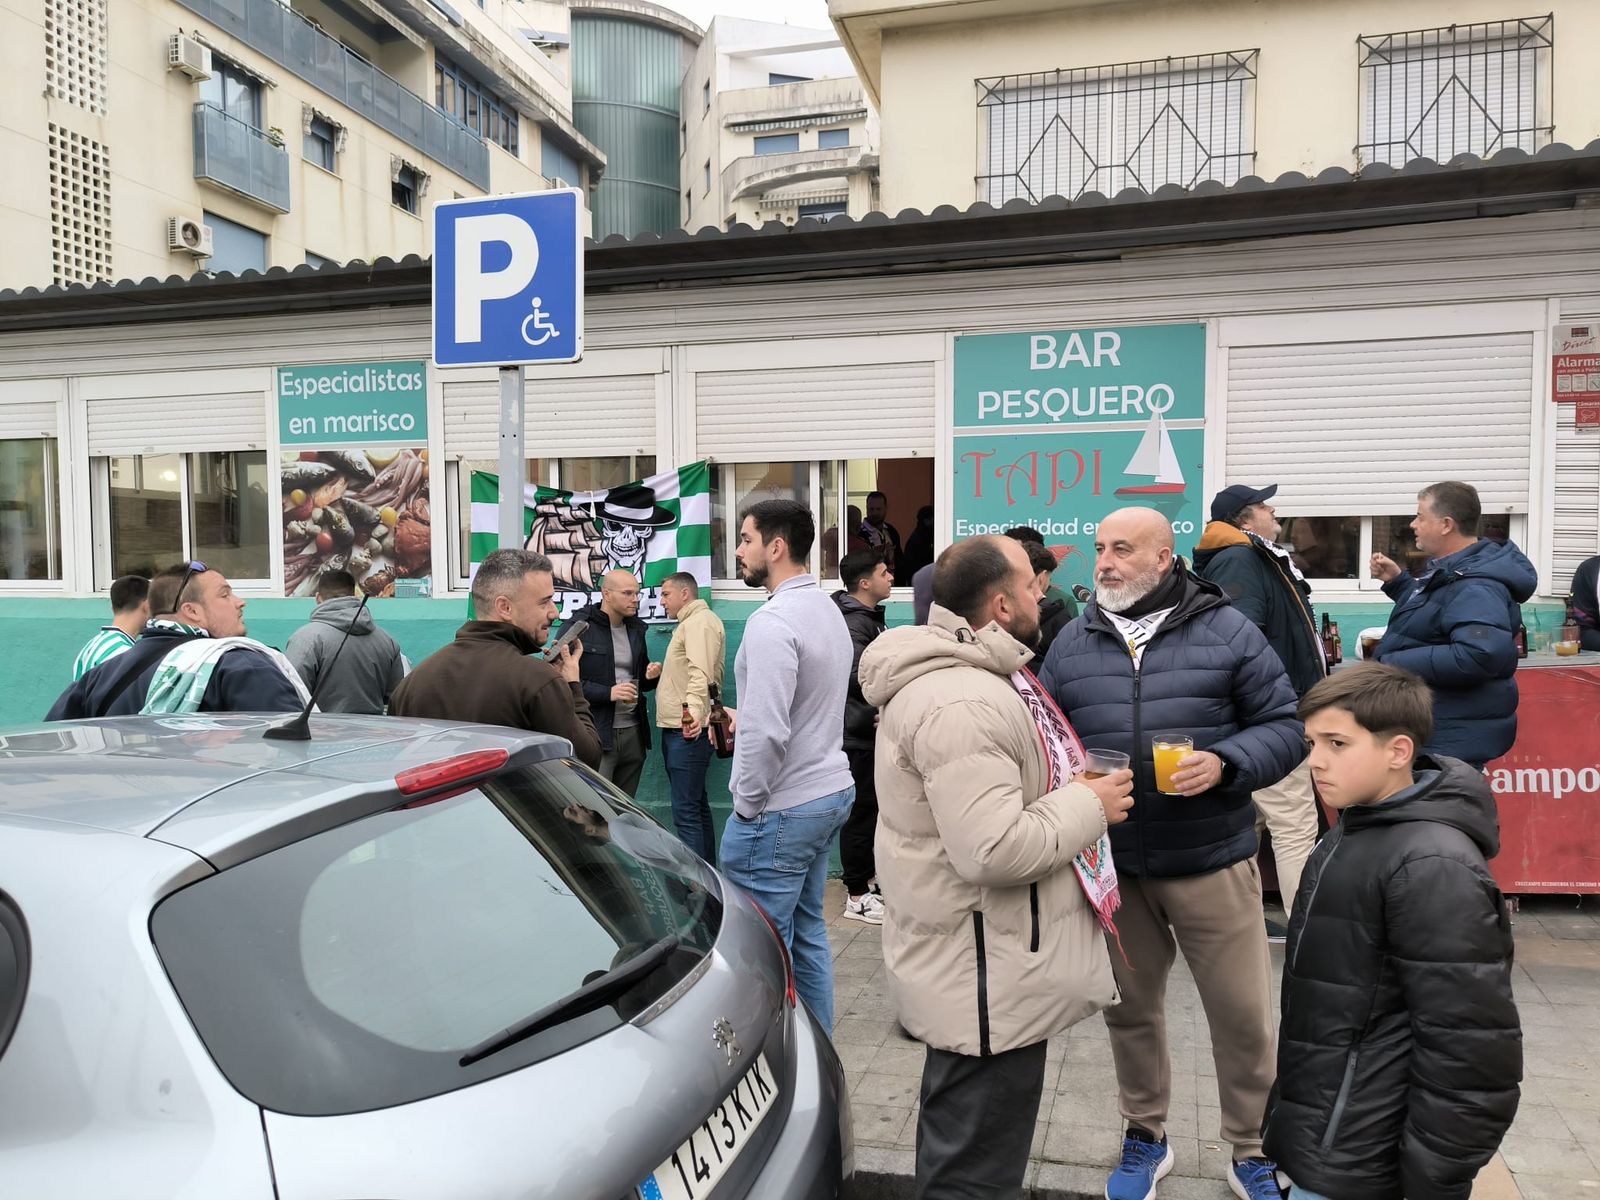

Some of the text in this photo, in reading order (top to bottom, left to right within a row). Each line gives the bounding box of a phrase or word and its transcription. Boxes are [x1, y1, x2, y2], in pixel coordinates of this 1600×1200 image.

[455, 213, 539, 344] P
[1030, 331, 1121, 370] BAR
[280, 368, 423, 400] Especialistas
[978, 383, 1175, 421] PESQUERO
[289, 409, 415, 435] en marisco
[960, 448, 1104, 507] TAPI
[1482, 766, 1600, 799] ampo
